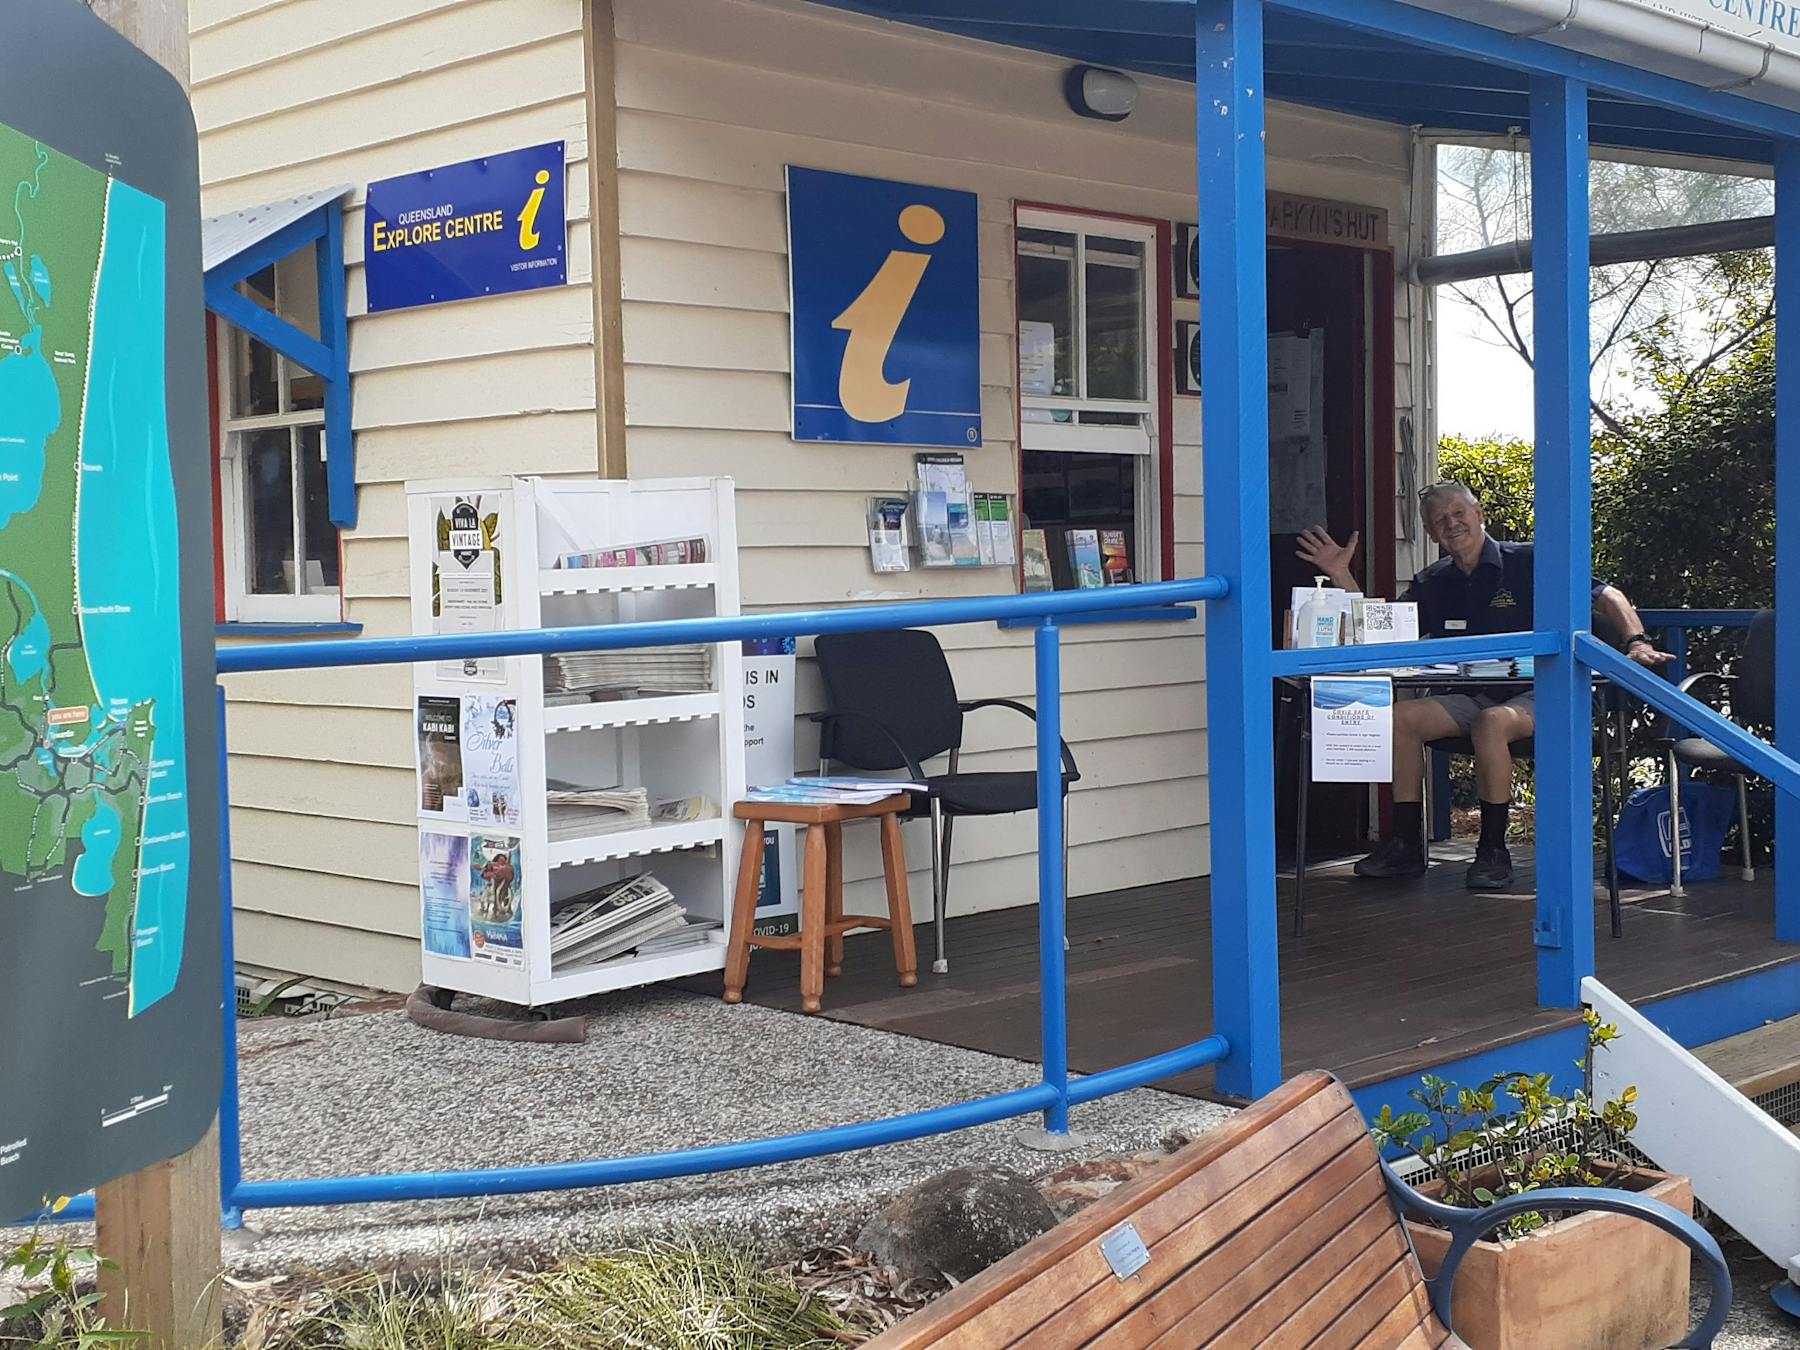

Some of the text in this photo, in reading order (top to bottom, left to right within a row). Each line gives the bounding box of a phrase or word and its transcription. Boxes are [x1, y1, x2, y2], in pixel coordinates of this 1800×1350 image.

[398, 204, 453, 225] QUEENSLAND
[373, 210, 504, 252] EXPLORE CENTRE
[1347, 208, 1379, 240] HUT
[510, 258, 558, 272] VISITOR INFORMATION
[831, 204, 946, 423] i
[454, 517, 476, 530] VIVA LA
[452, 532, 481, 548] VINTAGE
[1317, 615, 1334, 623] HAND
[745, 669, 779, 685] IS IN
[422, 722, 455, 733] KABI KABI
[744, 736, 764, 747] pport
[753, 922, 790, 937] OVID-19
